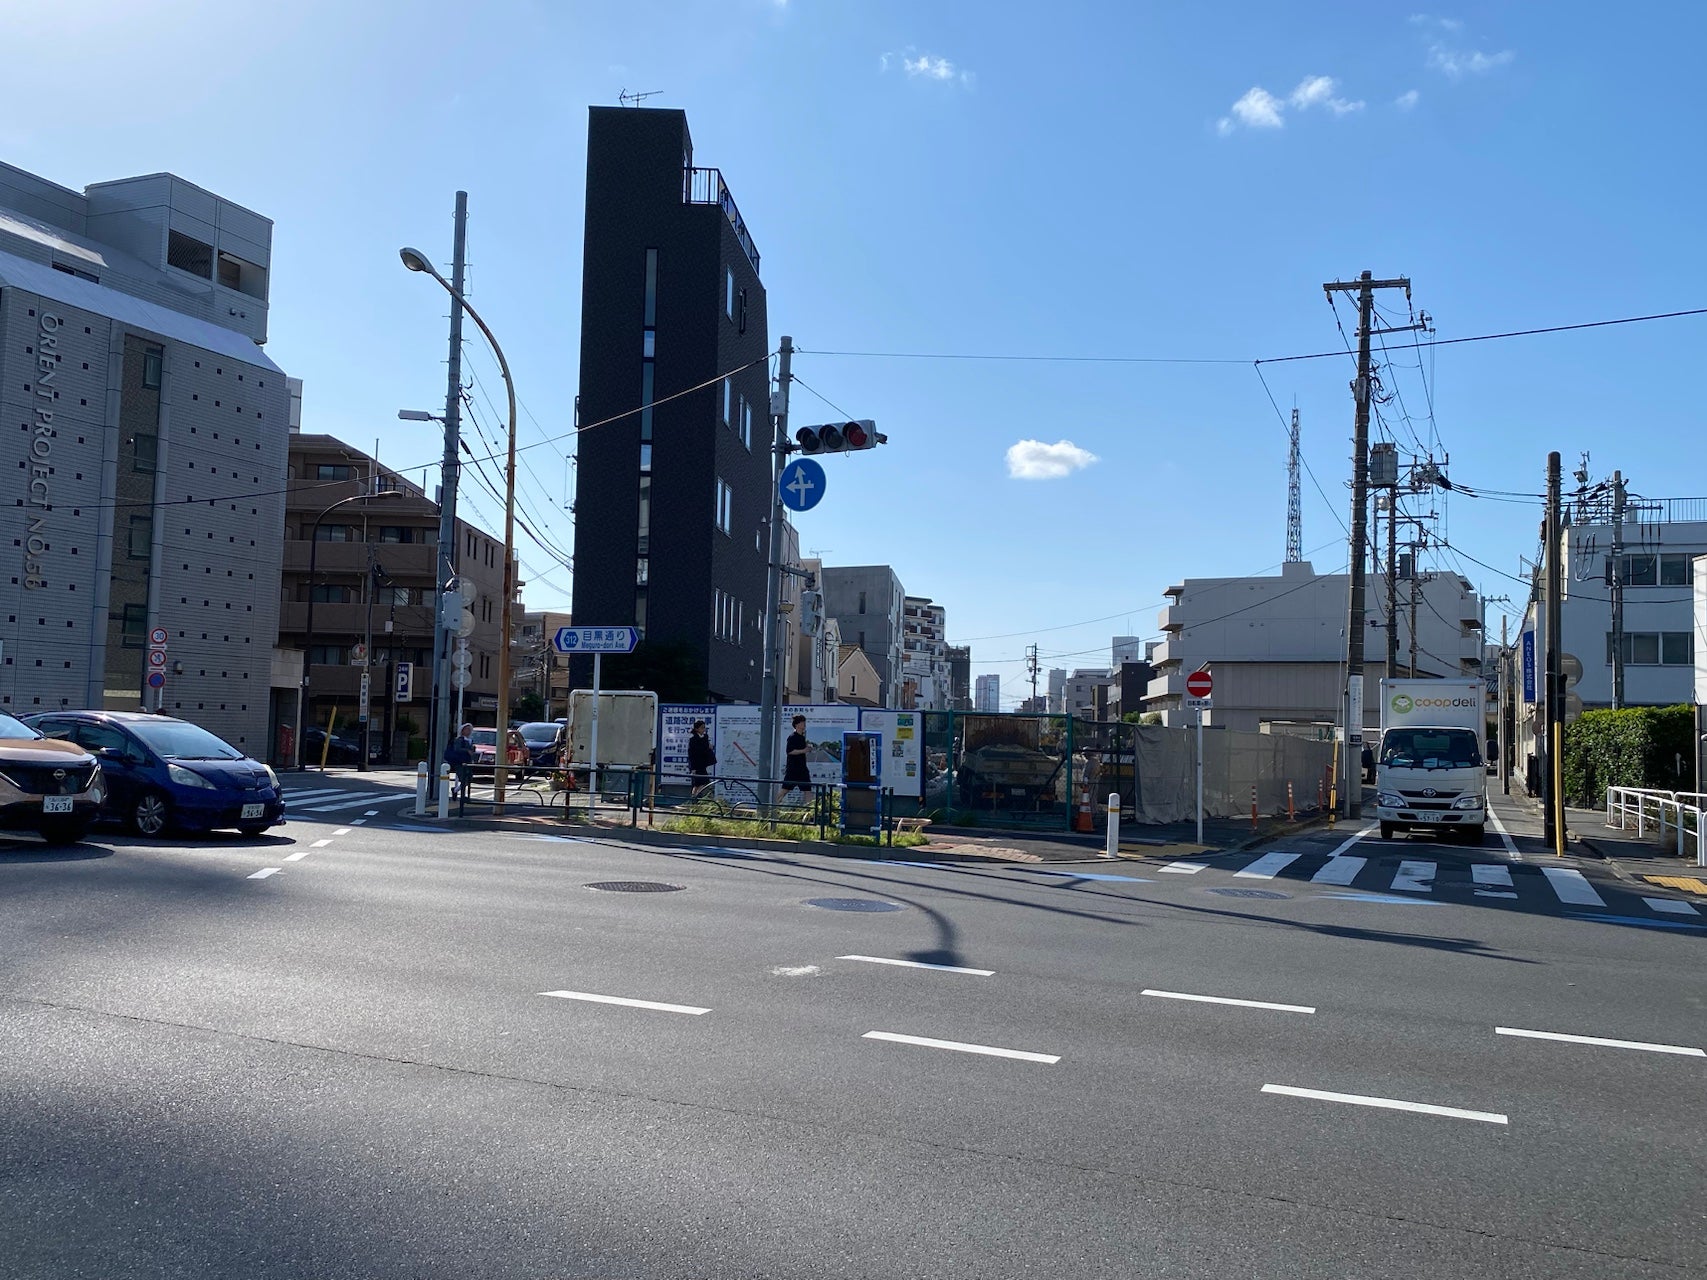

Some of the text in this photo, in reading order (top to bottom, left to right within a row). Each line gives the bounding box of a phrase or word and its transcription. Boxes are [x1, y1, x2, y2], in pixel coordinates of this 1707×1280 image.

[36, 312, 58, 402] ORIENT
[29, 408, 53, 508] PROJECT
[155, 632, 165, 640] 30
[565, 635, 577, 645] 312
[583, 630, 625, 641] 目黒通り
[581, 641, 626, 650] Meguro-dori Ave.
[397, 673, 408, 691] P
[665, 716, 712, 725] 道路改良事
